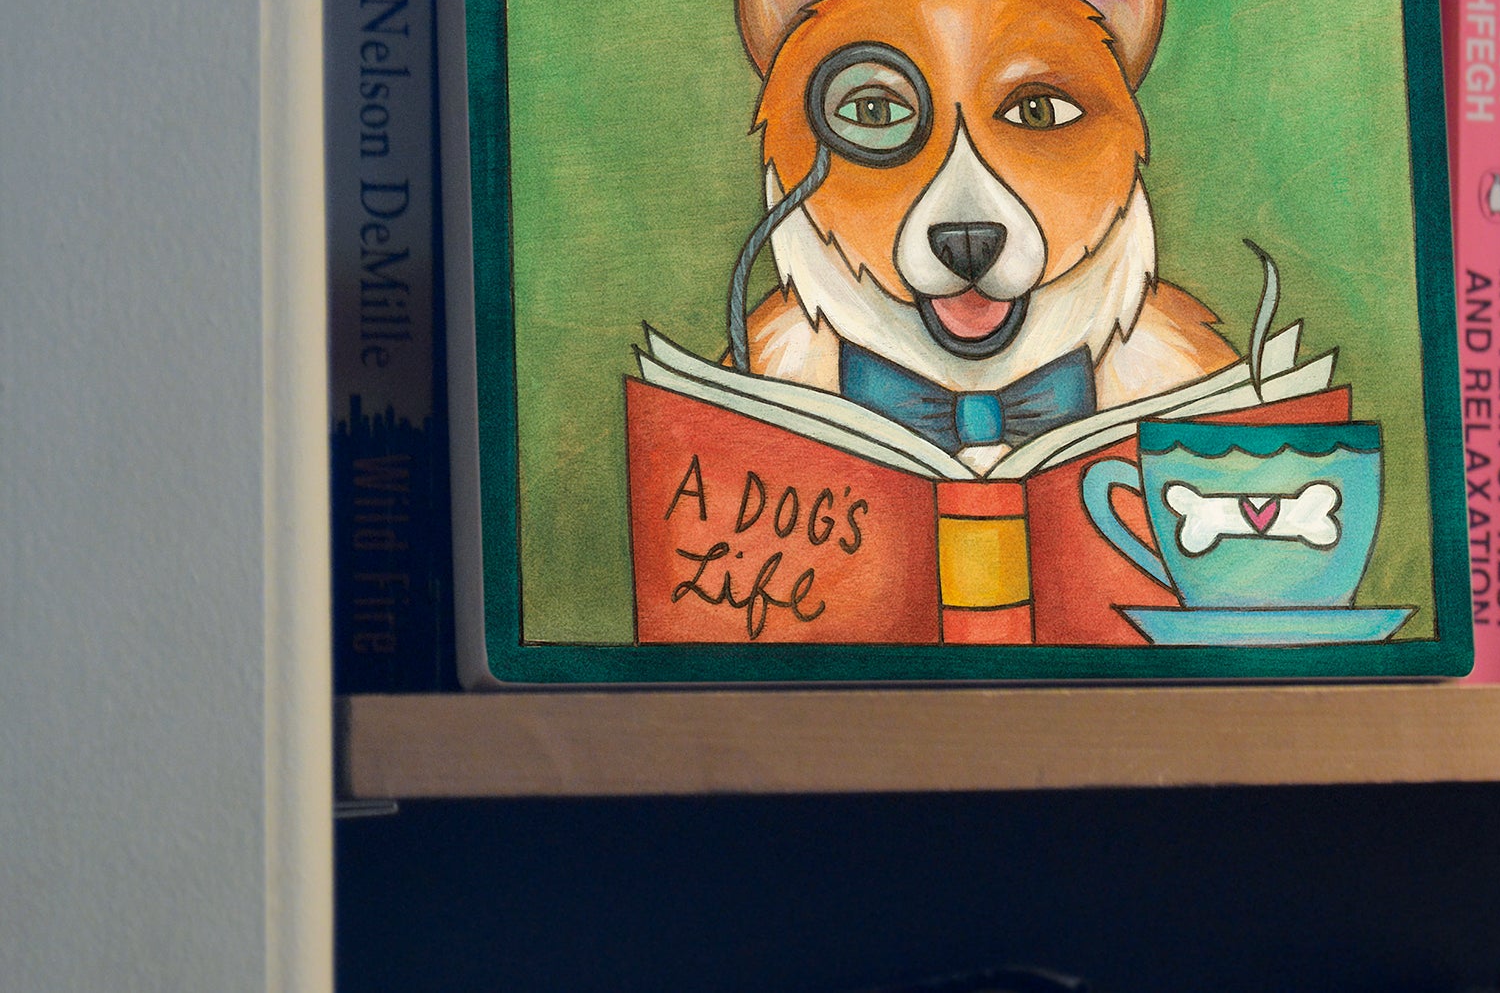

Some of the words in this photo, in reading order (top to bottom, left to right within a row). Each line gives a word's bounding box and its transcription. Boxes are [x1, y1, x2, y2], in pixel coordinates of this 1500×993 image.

[359, 179, 412, 370] DeMille
[1464, 268, 1494, 354] AND
[352, 454, 411, 552] Wild
[663, 453, 708, 523] A
[734, 469, 870, 556] DOG'S
[1464, 368, 1493, 627] RELAXATION
[353, 571, 411, 654] Fire
[670, 539, 828, 641] Life
